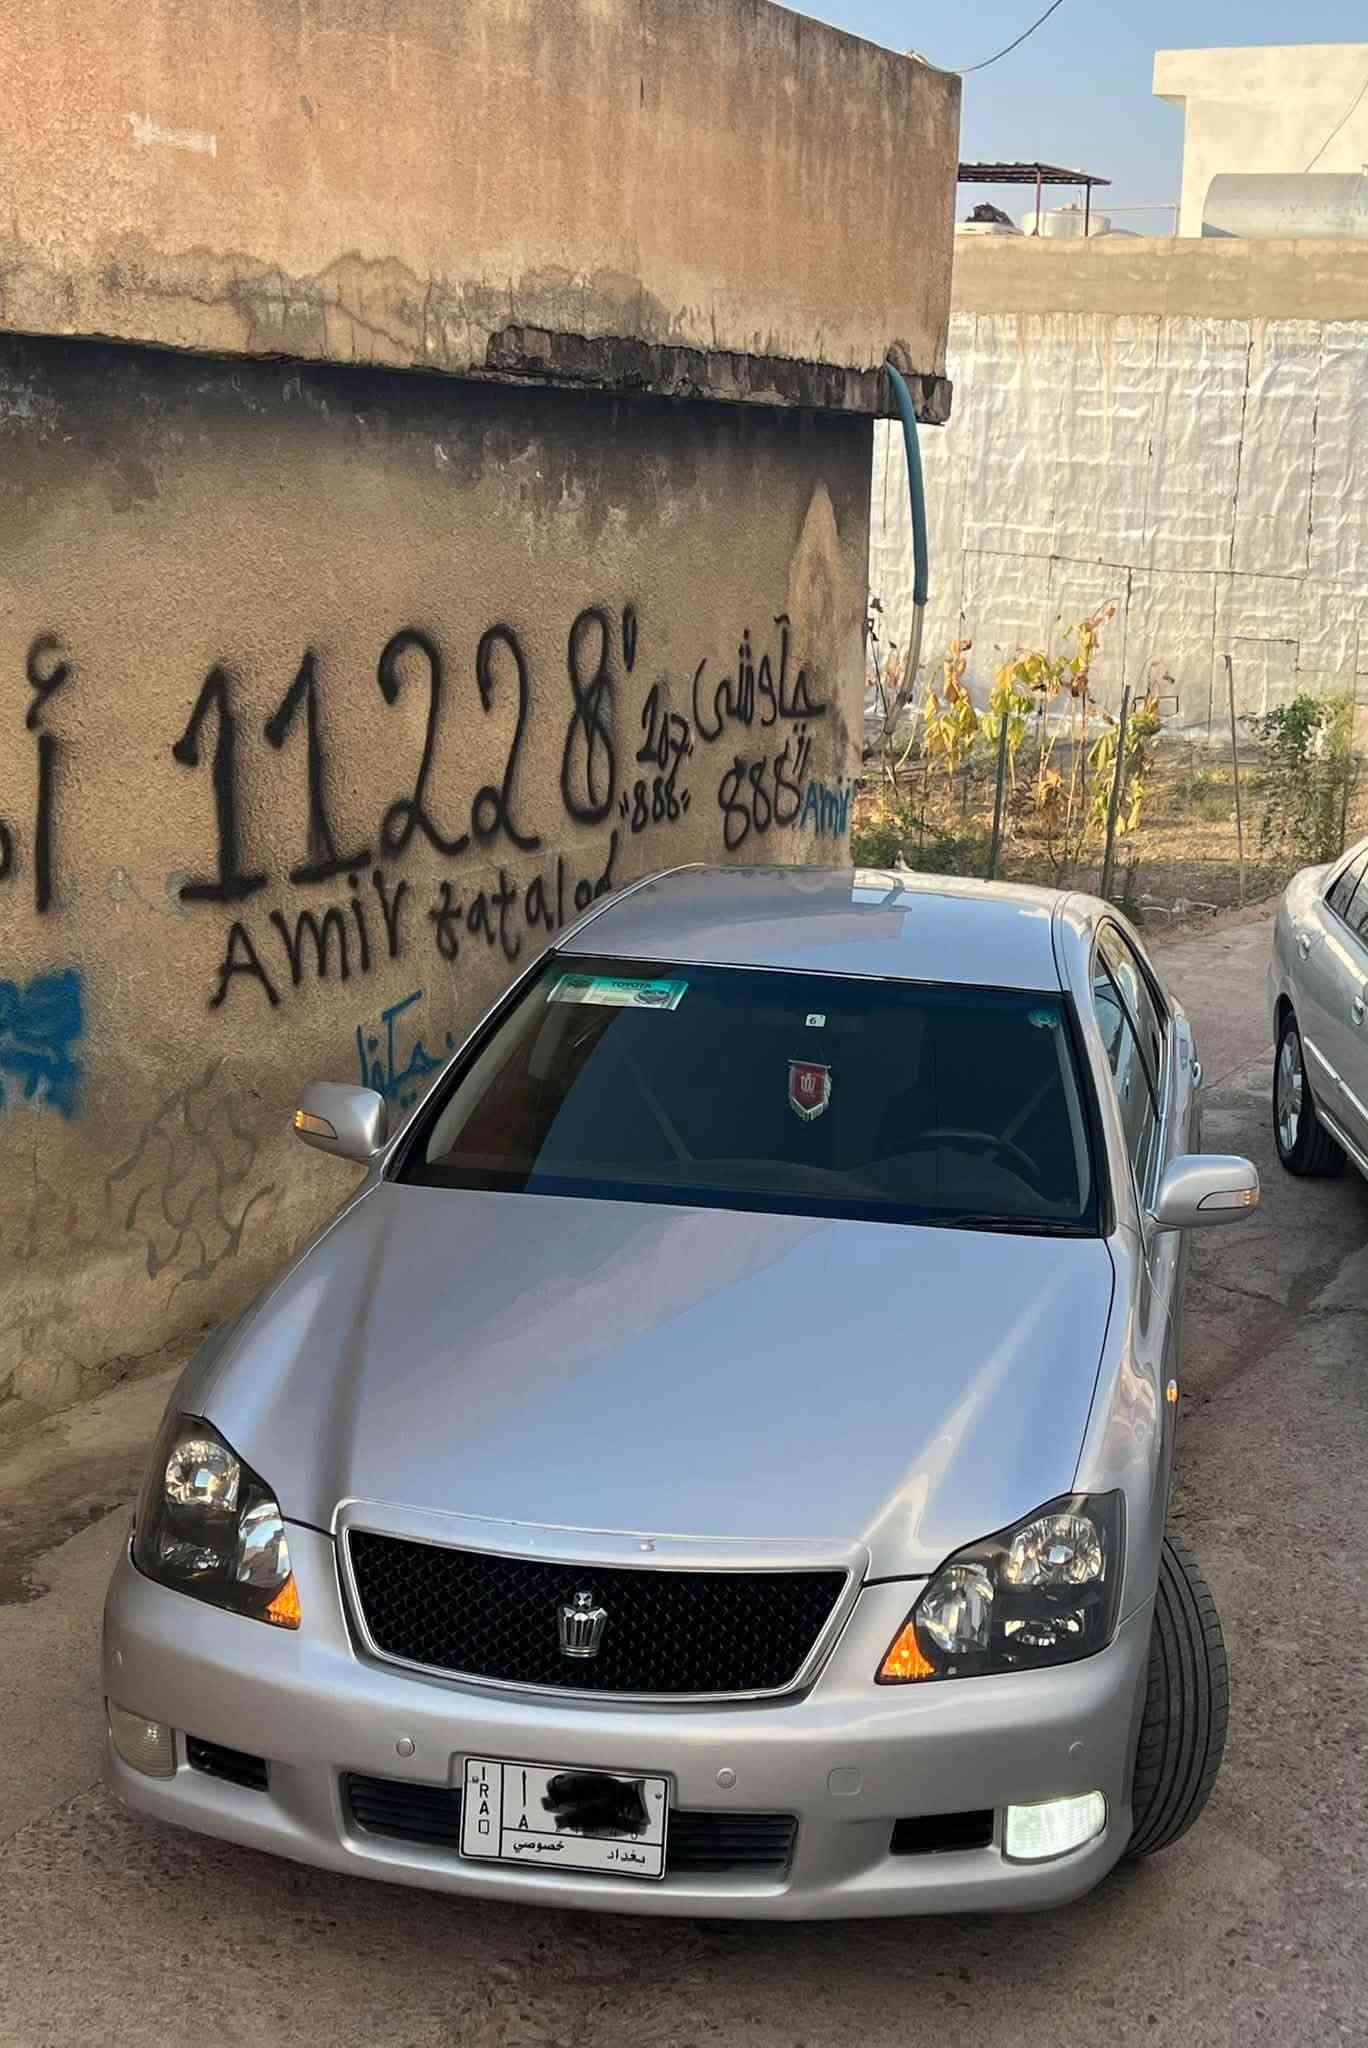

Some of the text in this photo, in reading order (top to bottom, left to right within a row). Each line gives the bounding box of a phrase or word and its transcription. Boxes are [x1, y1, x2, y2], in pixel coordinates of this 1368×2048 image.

[611, 981, 653, 990] TOYOTA
[512, 1840, 646, 1868] بغداد خصوصي
